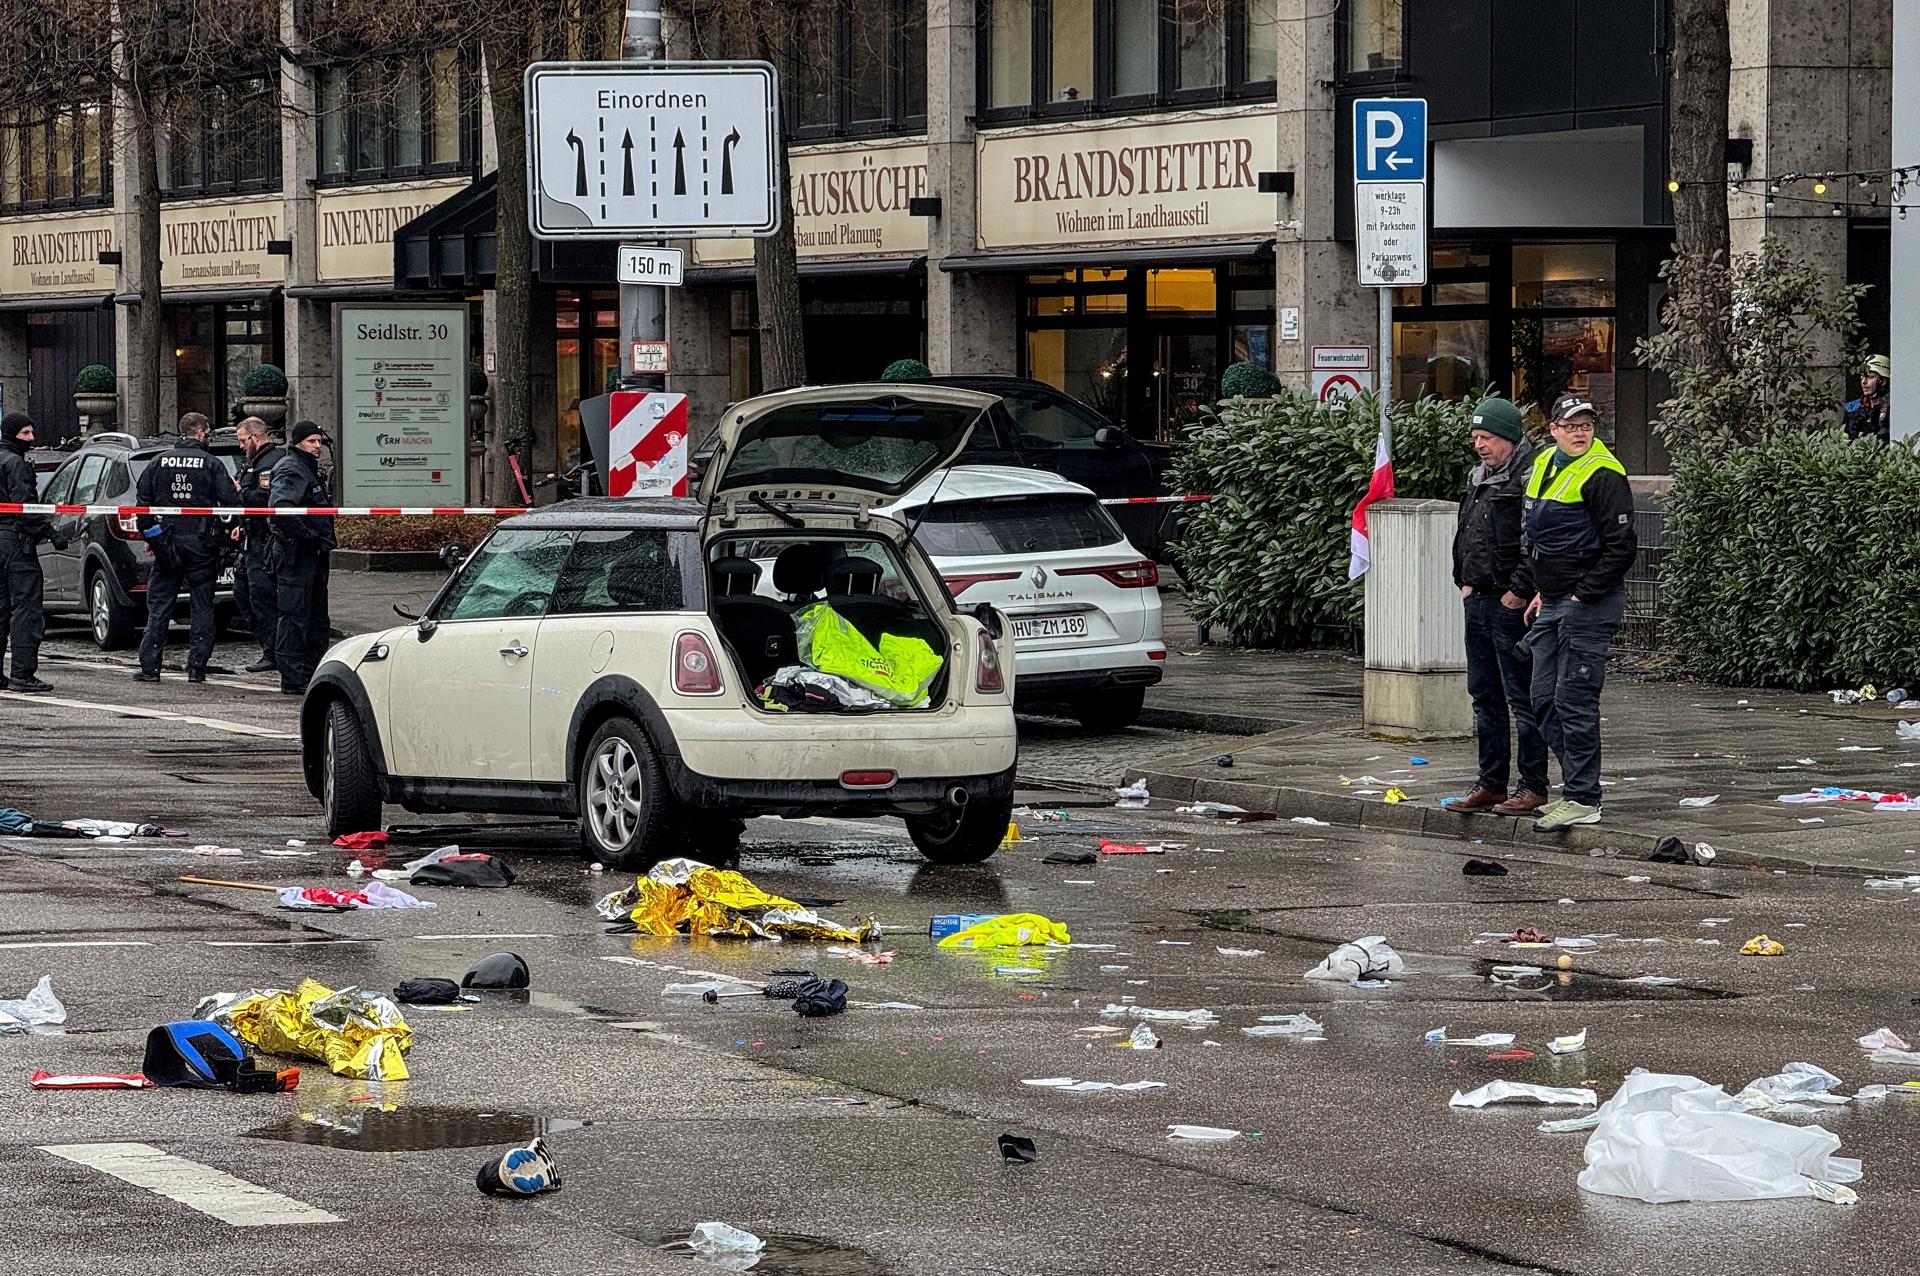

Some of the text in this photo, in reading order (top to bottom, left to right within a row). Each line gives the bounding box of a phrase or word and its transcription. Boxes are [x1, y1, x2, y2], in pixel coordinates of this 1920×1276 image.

[597, 89, 707, 109] Einordnen
[1366, 111, 1404, 171] P
[1014, 138, 1256, 203] BRANDSTETTER
[1375, 190, 1405, 202] werktags
[1056, 201, 1209, 234] Wohnen im Landhausstil
[1380, 206, 1401, 216] 9-23h
[166, 209, 277, 256] WERKSTÄTTEN
[1366, 220, 1416, 231] mit Parkschein
[818, 224, 837, 245] und
[840, 223, 882, 248] Planung
[1383, 237, 1399, 246] oder
[13, 229, 112, 266] BRANDSTETTER
[1371, 251, 1412, 262] Parkausweis
[182, 259, 260, 279] Innenausbau und Planung
[630, 256, 671, 275] 150 m
[31, 267, 95, 286] Wohnen im Landhausstil
[357, 324, 448, 340] Seidlstr. 30
[1317, 353, 1365, 362] Feuerwehrzufahrt
[384, 437, 400, 445] SRH
[161, 456, 204, 469] POLIZEI
[175, 473, 187, 483] BY
[171, 482, 192, 492] 6240
[1008, 591, 1073, 600] TALISMAN
[1041, 620, 1060, 635] ZM
[1061, 618, 1085, 633] 189
